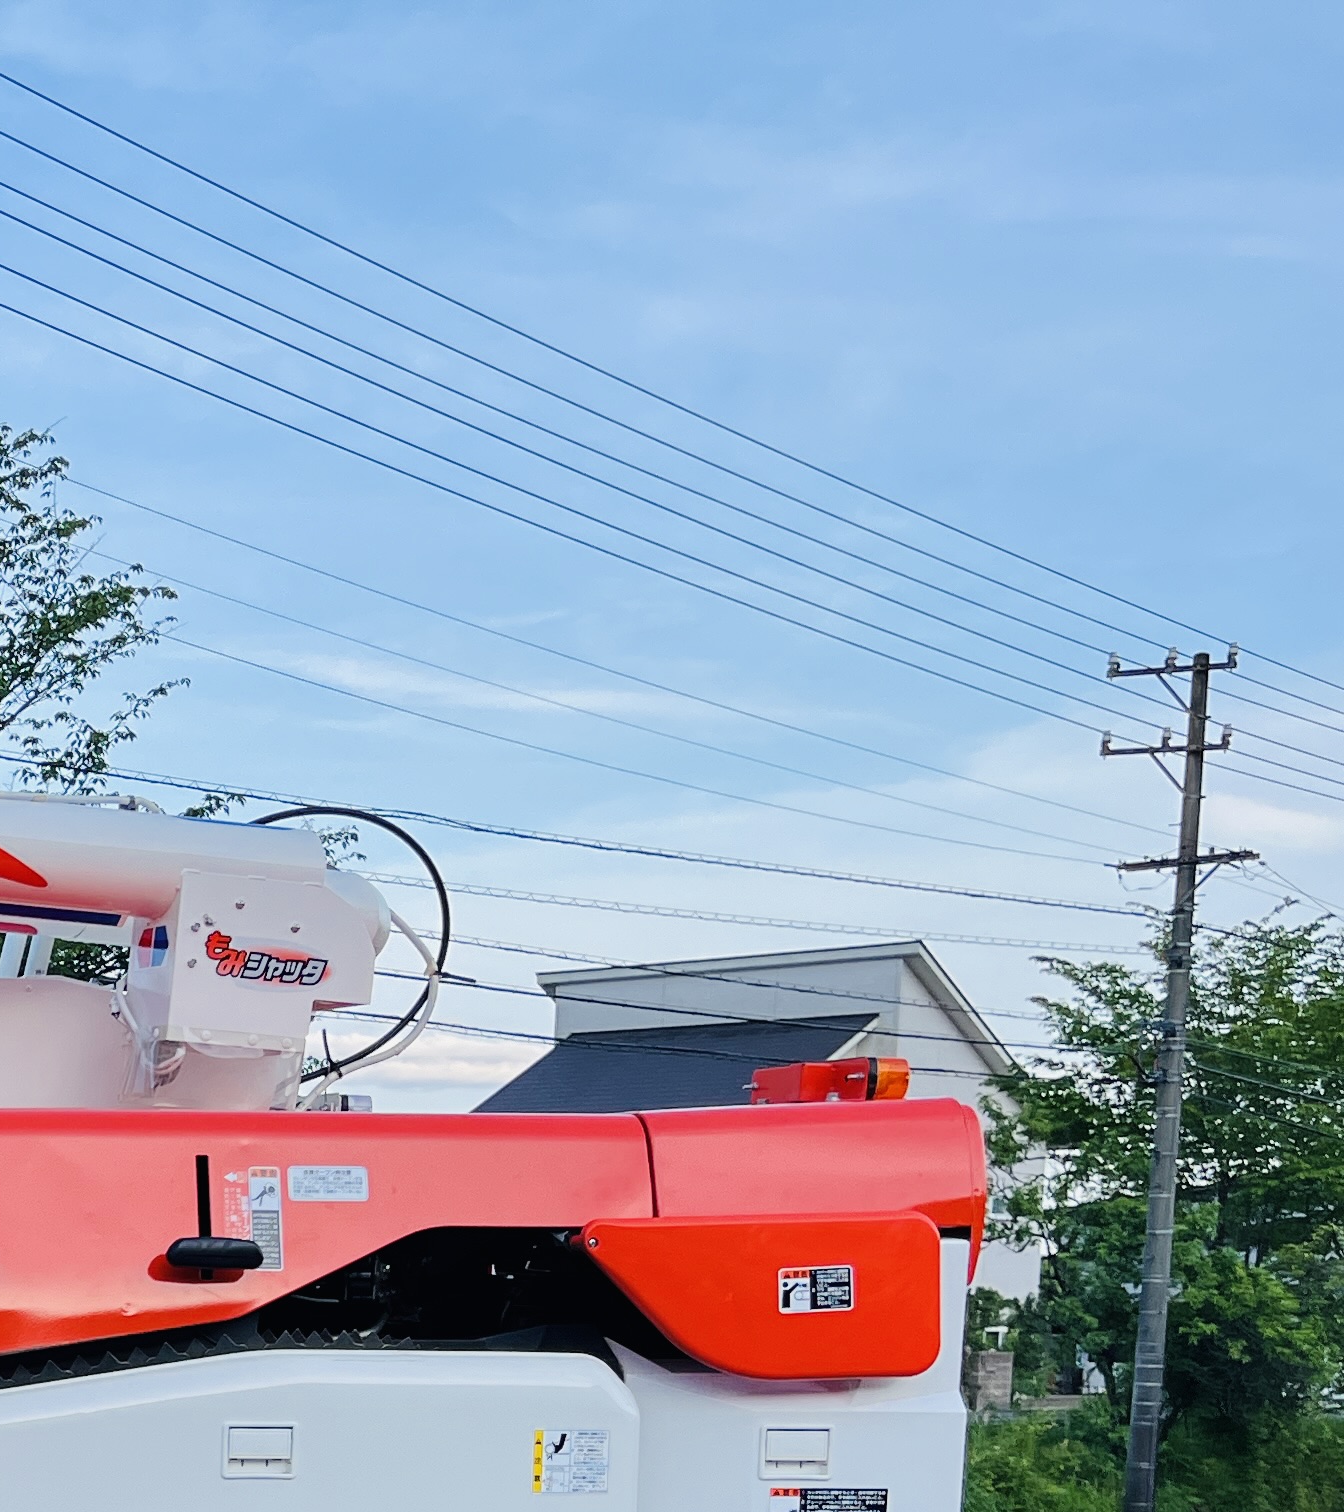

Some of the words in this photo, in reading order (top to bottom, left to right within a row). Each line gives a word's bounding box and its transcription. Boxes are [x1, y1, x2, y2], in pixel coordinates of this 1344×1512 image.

[205, 930, 329, 986] もみシャッタ
